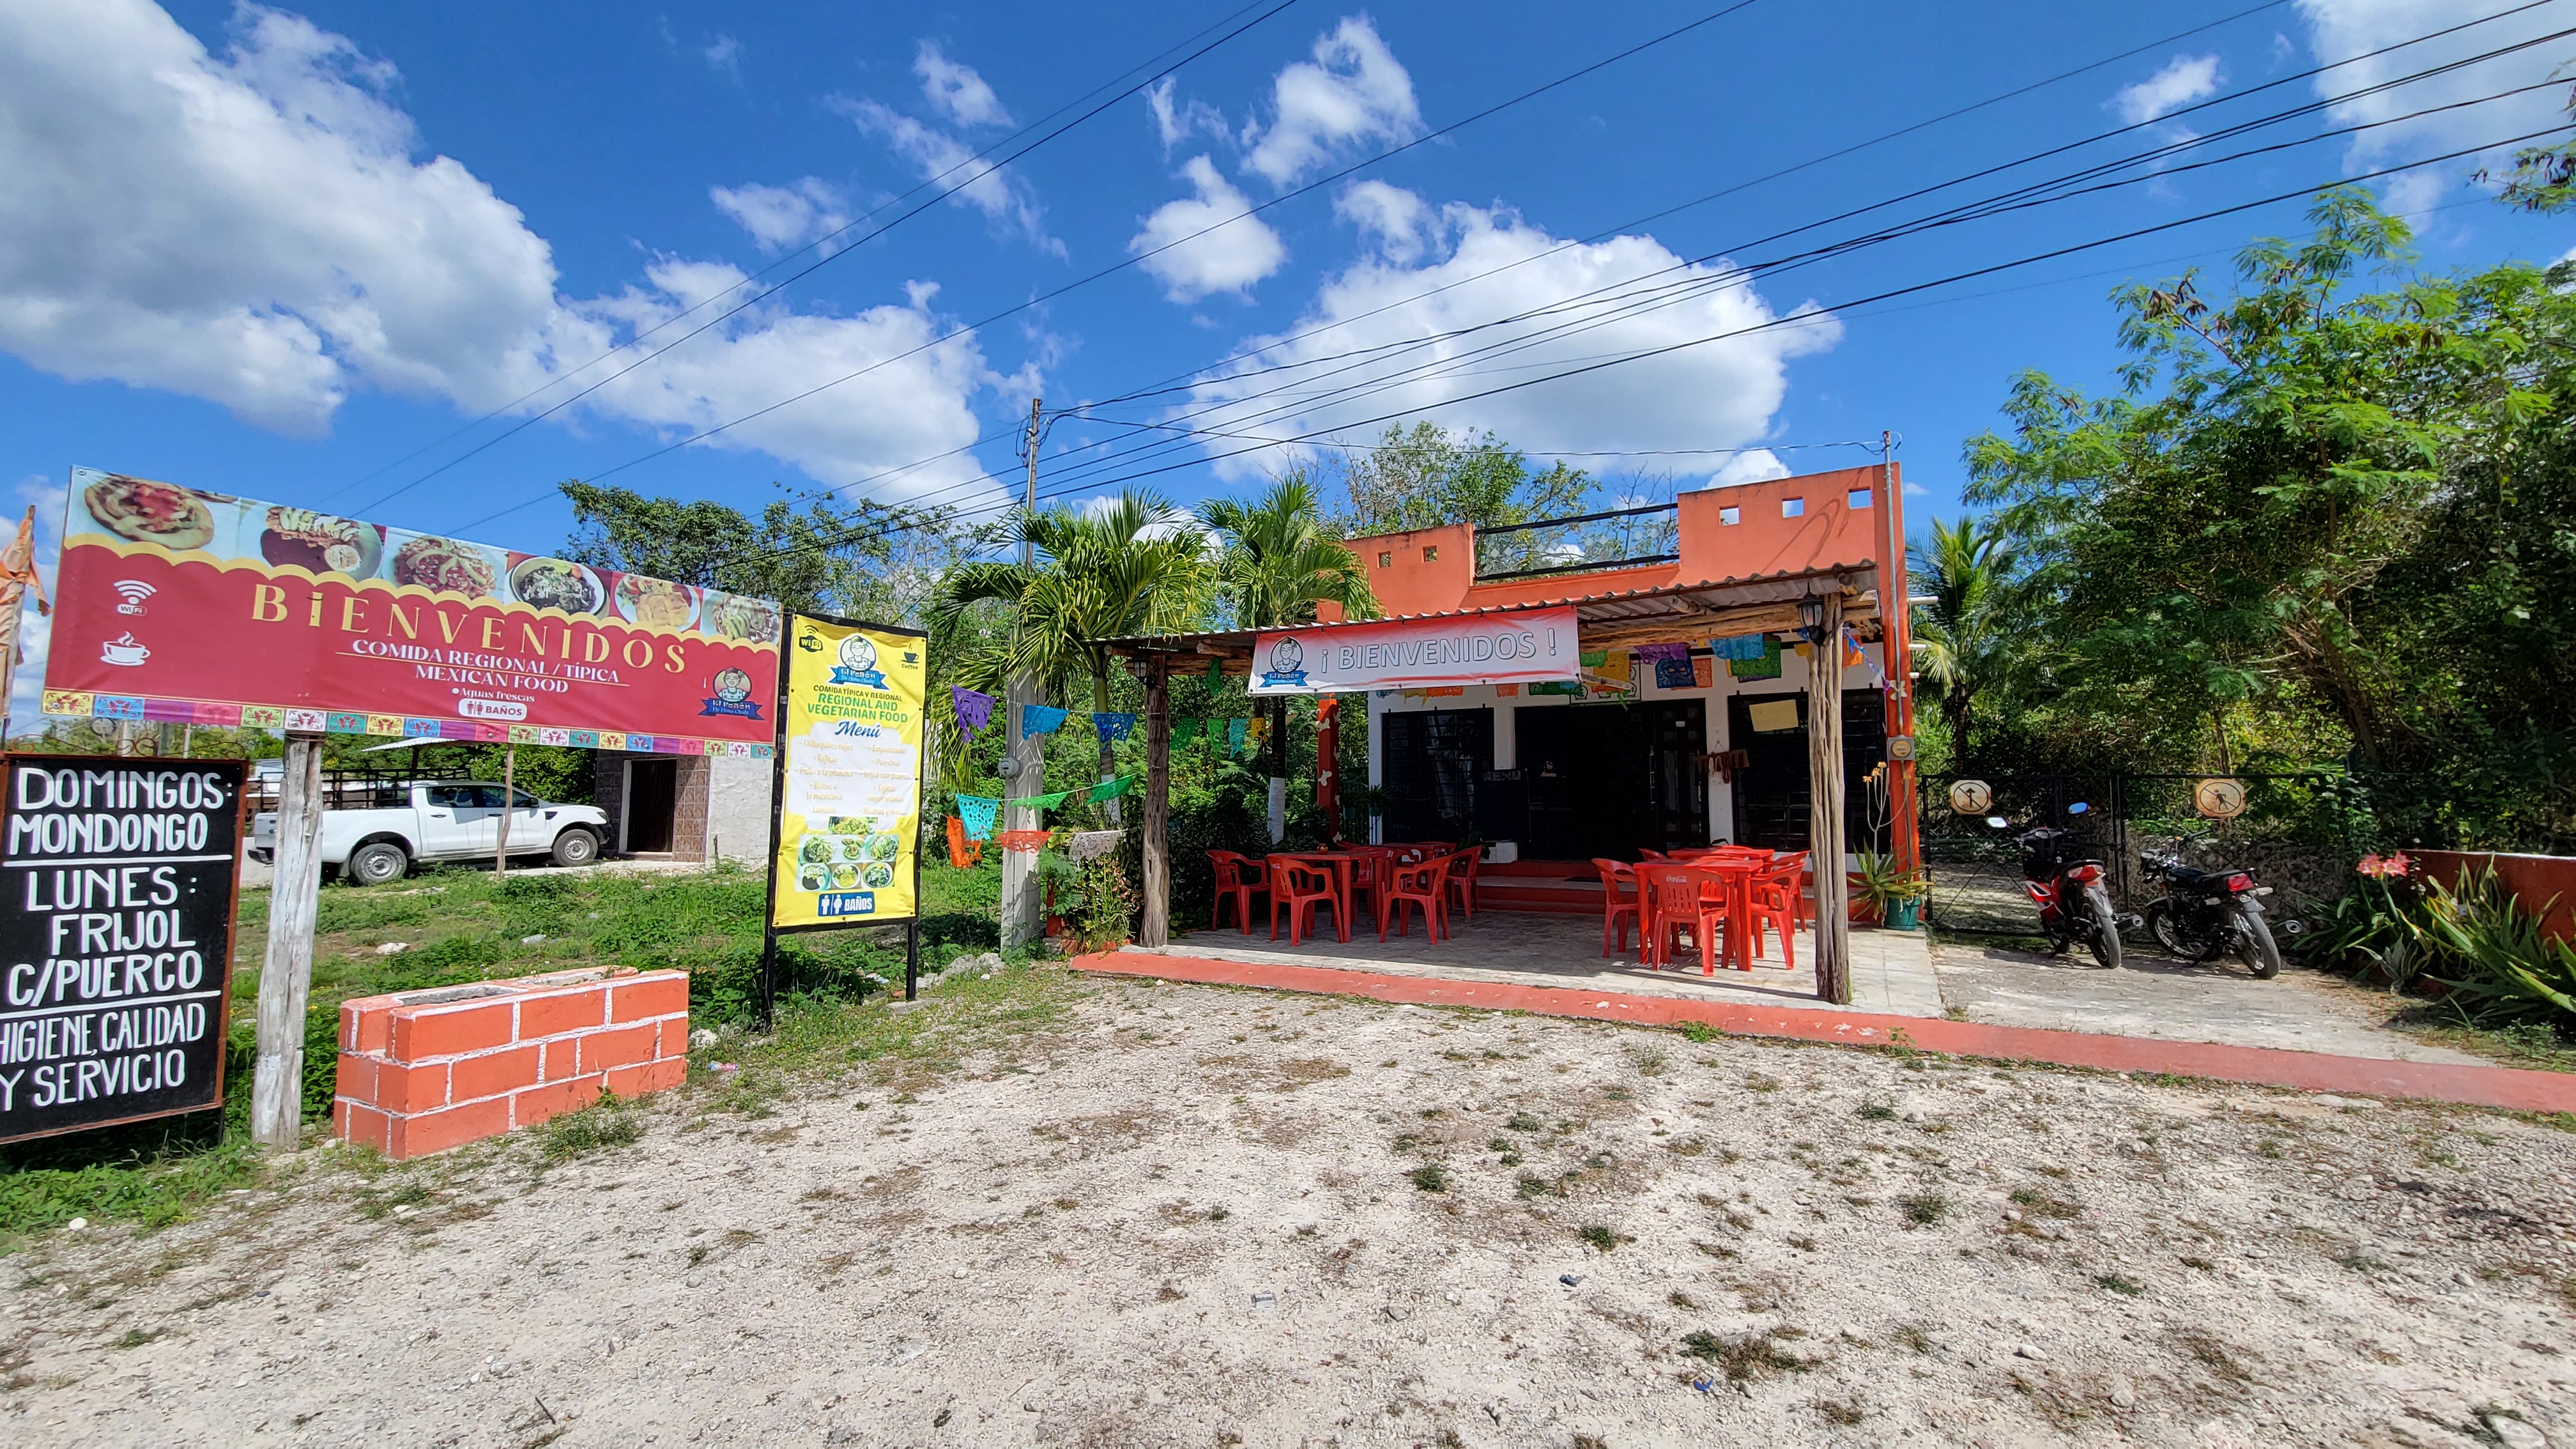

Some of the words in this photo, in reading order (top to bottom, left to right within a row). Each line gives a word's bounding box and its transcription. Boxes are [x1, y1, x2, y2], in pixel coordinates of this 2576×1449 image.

[353, 640, 442, 663] COMIDA
[448, 650, 549, 675] REGIONAL
[564, 662, 619, 682] TÍPICA
[1338, 631, 1537, 670] BIENVENIDOS
[415, 665, 508, 686] MEXICAN
[514, 675, 568, 693] FOOD
[460, 687, 494, 698] Aguas
[496, 691, 535, 702] frescas
[813, 685, 842, 694] COMIDA
[843, 687, 863, 698] TÍPICA
[870, 692, 903, 702] REGIONAL
[818, 693, 873, 709] REGIONAL
[875, 700, 898, 711] AND
[486, 705, 523, 716] BAÑOS
[808, 703, 877, 720] VEGETARIAN
[879, 711, 908, 723] FOOD
[834, 721, 882, 738] Menú
[9, 812, 209, 855] MONDONGO
[844, 896, 873, 912] BAÑOS
[50, 909, 197, 956] FRIJOL
[8, 950, 204, 1007] C/PUERCO
[100, 1002, 206, 1052] CALIDAD
[0, 1069, 26, 1112] Y
[33, 1049, 186, 1107] SERVICIO
